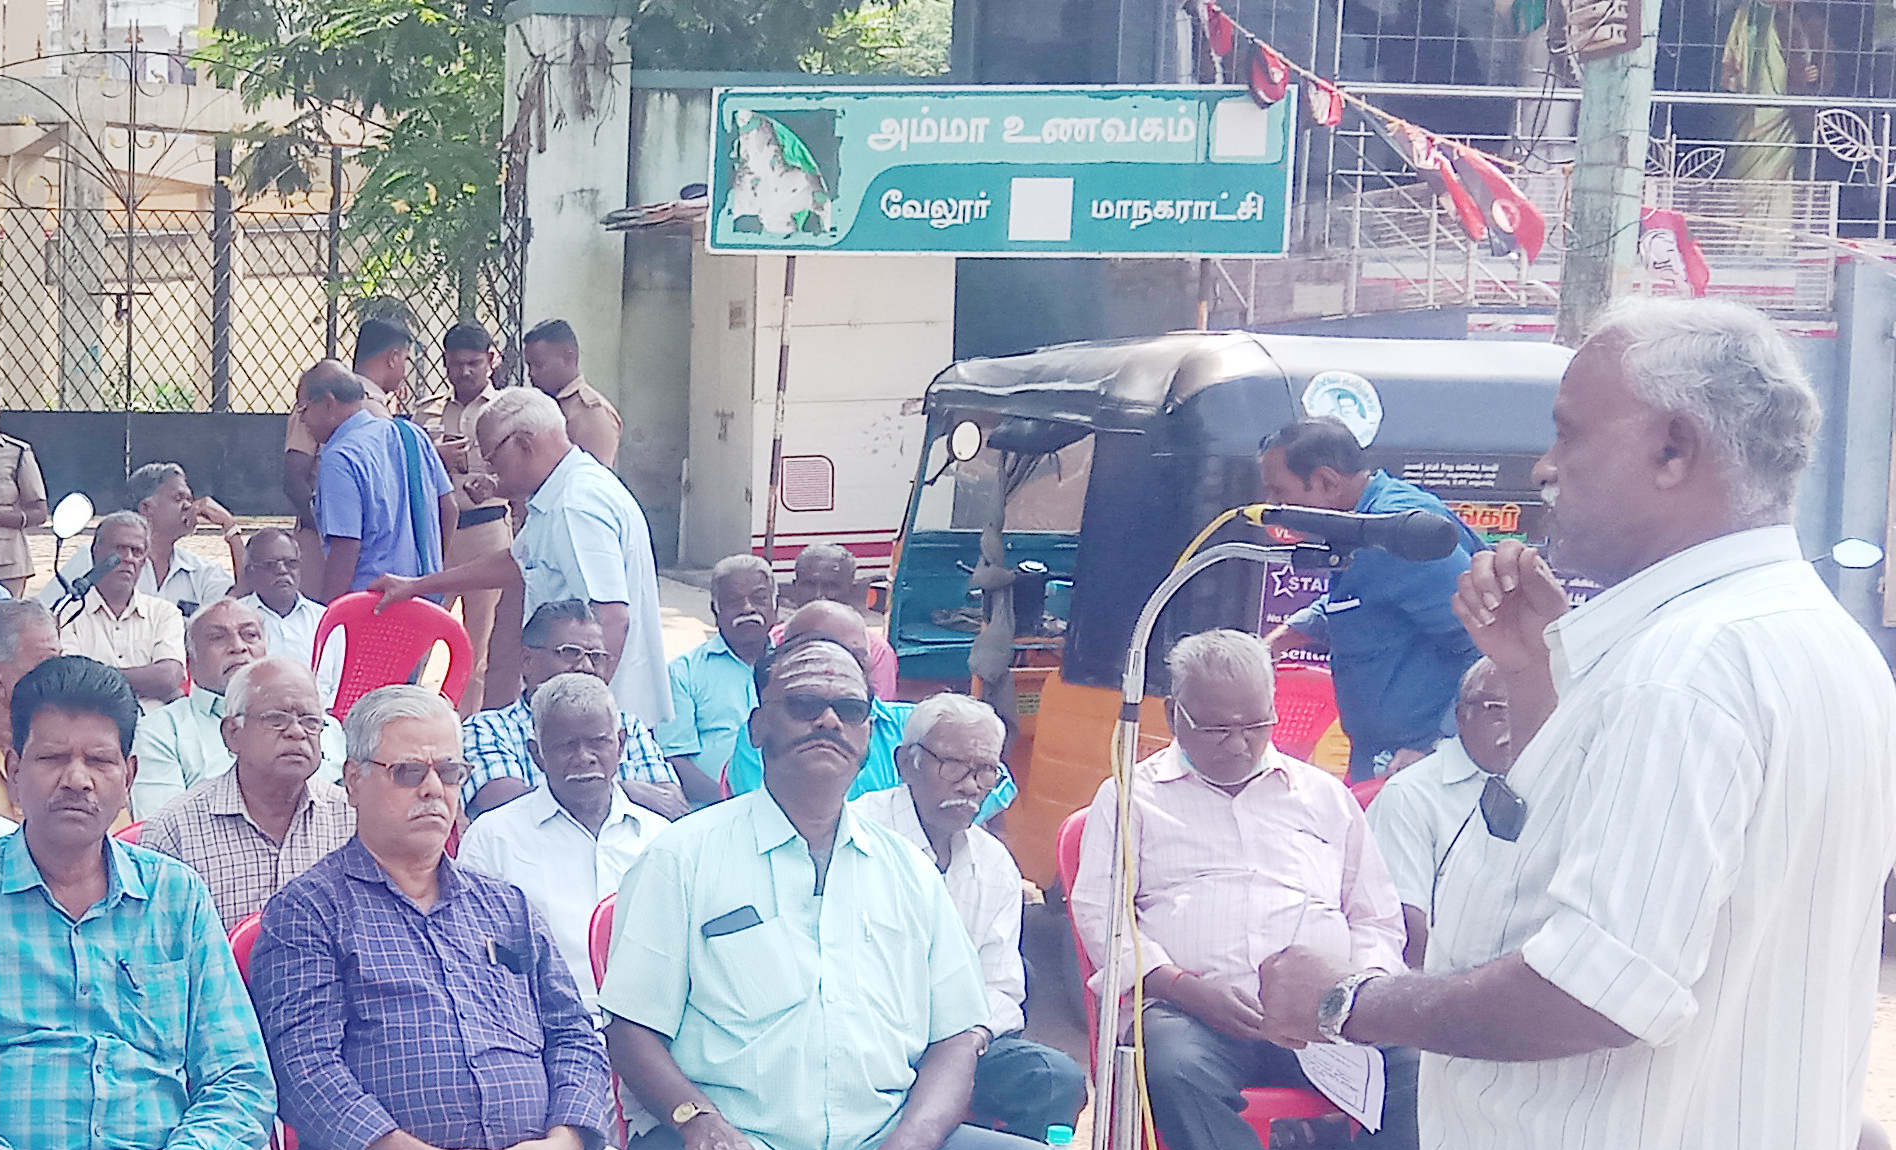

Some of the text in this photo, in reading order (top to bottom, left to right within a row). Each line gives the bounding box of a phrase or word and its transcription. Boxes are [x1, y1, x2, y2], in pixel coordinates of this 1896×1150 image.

[867, 105, 1197, 151] அம்மா உணவகம்
[880, 189, 1265, 231] வேலூர் மாநகராட்சி
